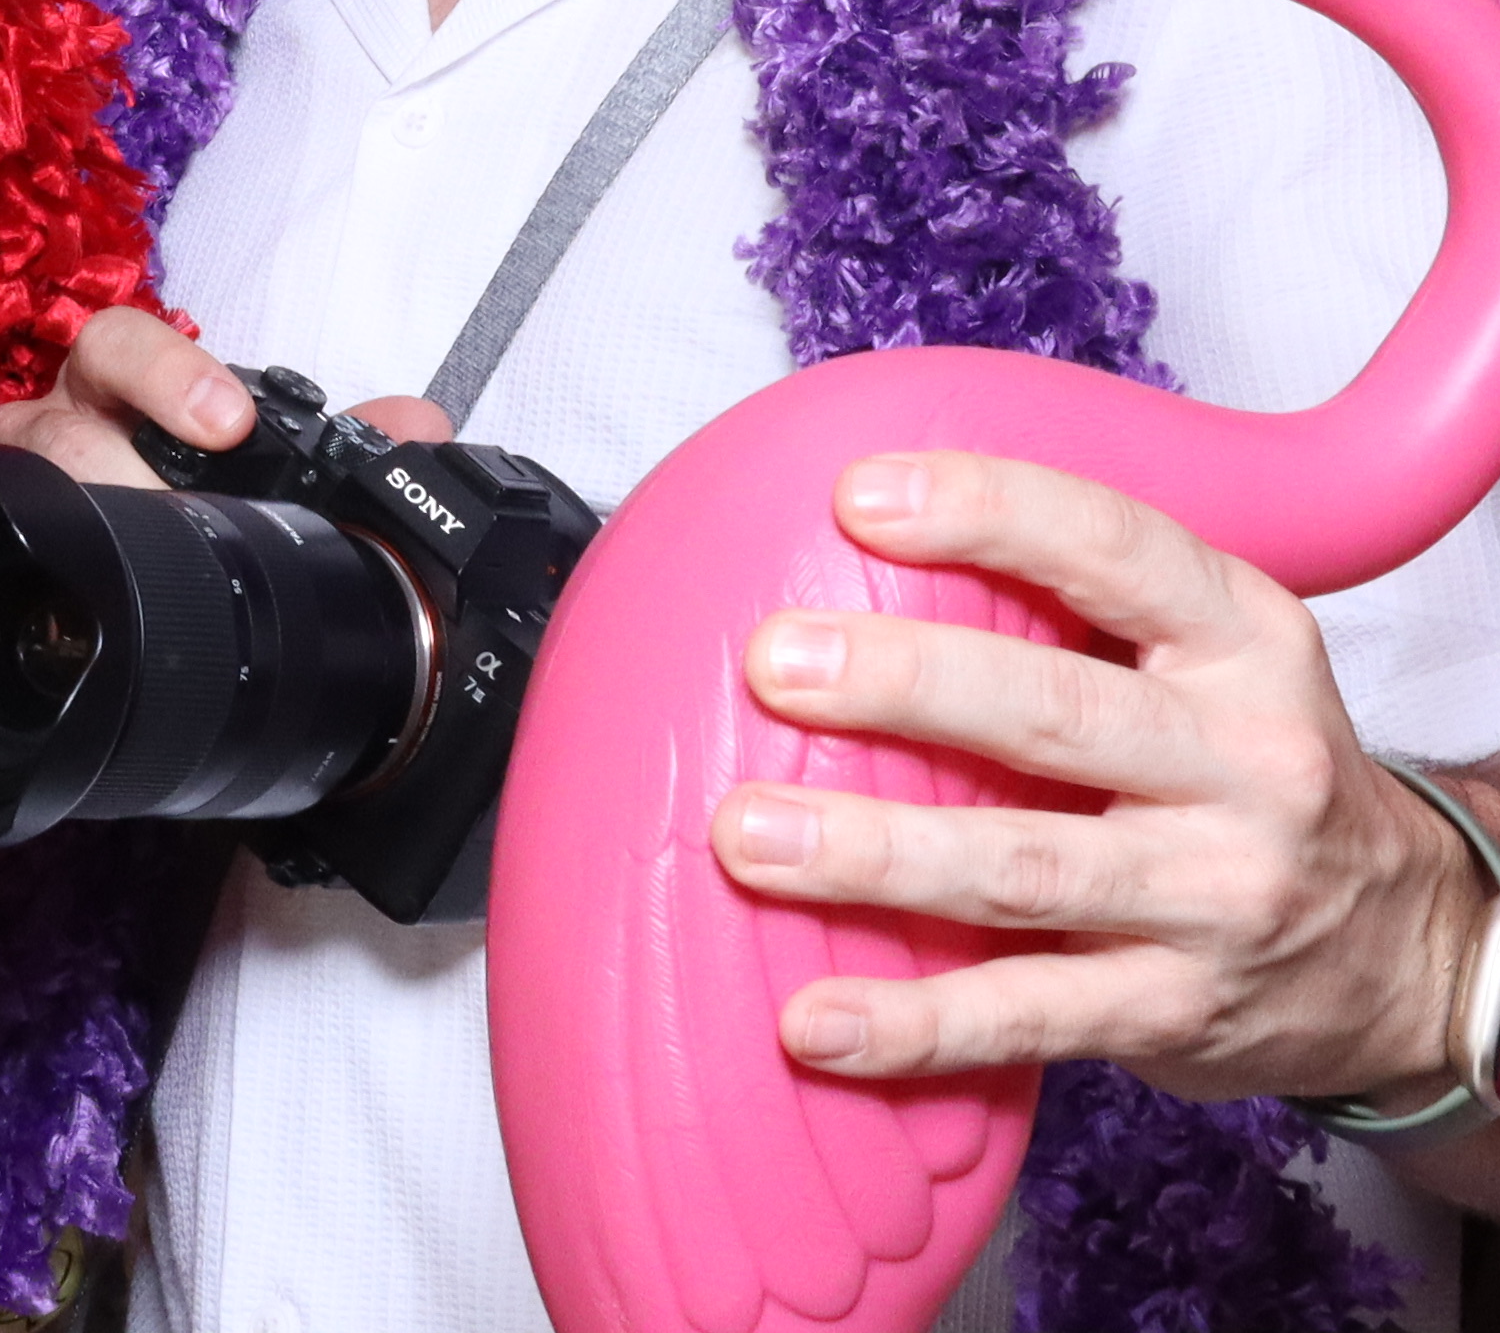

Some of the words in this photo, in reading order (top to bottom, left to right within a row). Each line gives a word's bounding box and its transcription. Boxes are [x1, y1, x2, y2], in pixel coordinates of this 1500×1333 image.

[386, 467, 466, 535] SONY
[231, 578, 243, 595] 50
[239, 665, 250, 682] 75
